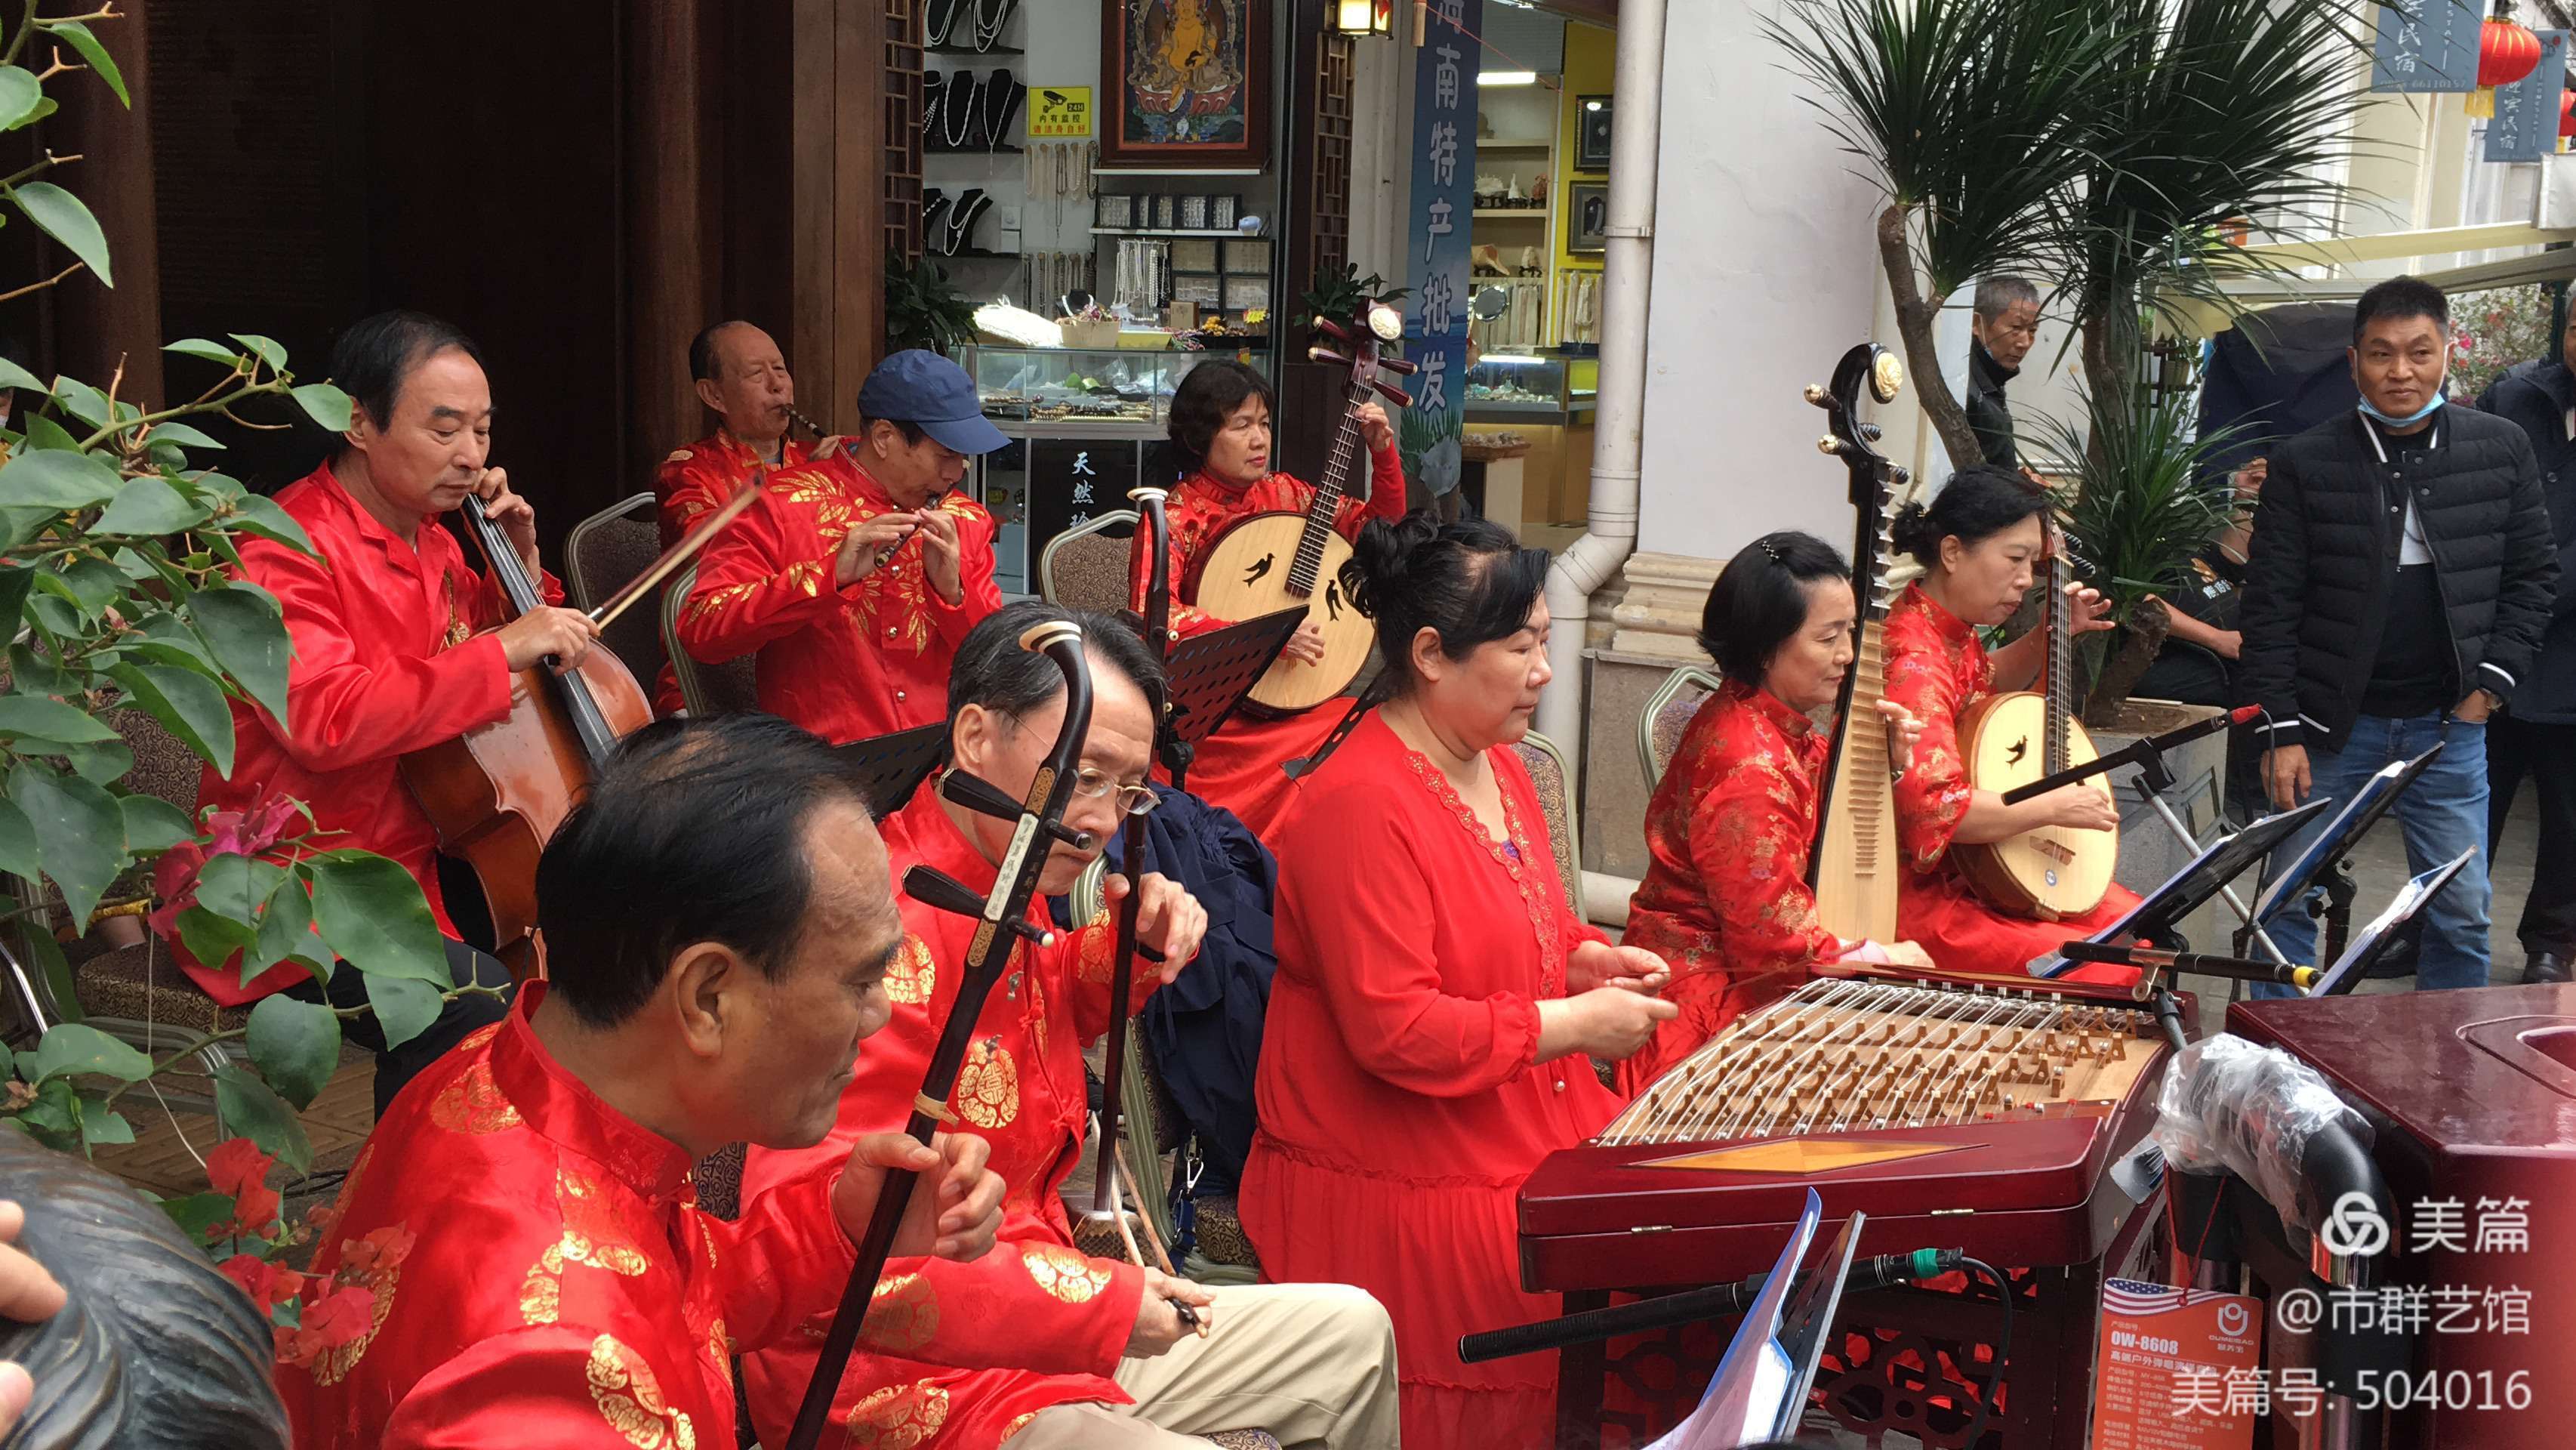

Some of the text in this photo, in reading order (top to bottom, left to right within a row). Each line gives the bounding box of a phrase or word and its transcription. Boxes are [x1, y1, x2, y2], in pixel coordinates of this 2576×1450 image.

[1040, 114, 1081, 123] 内有监控
[1033, 124, 1086, 134] 请洁身自好
